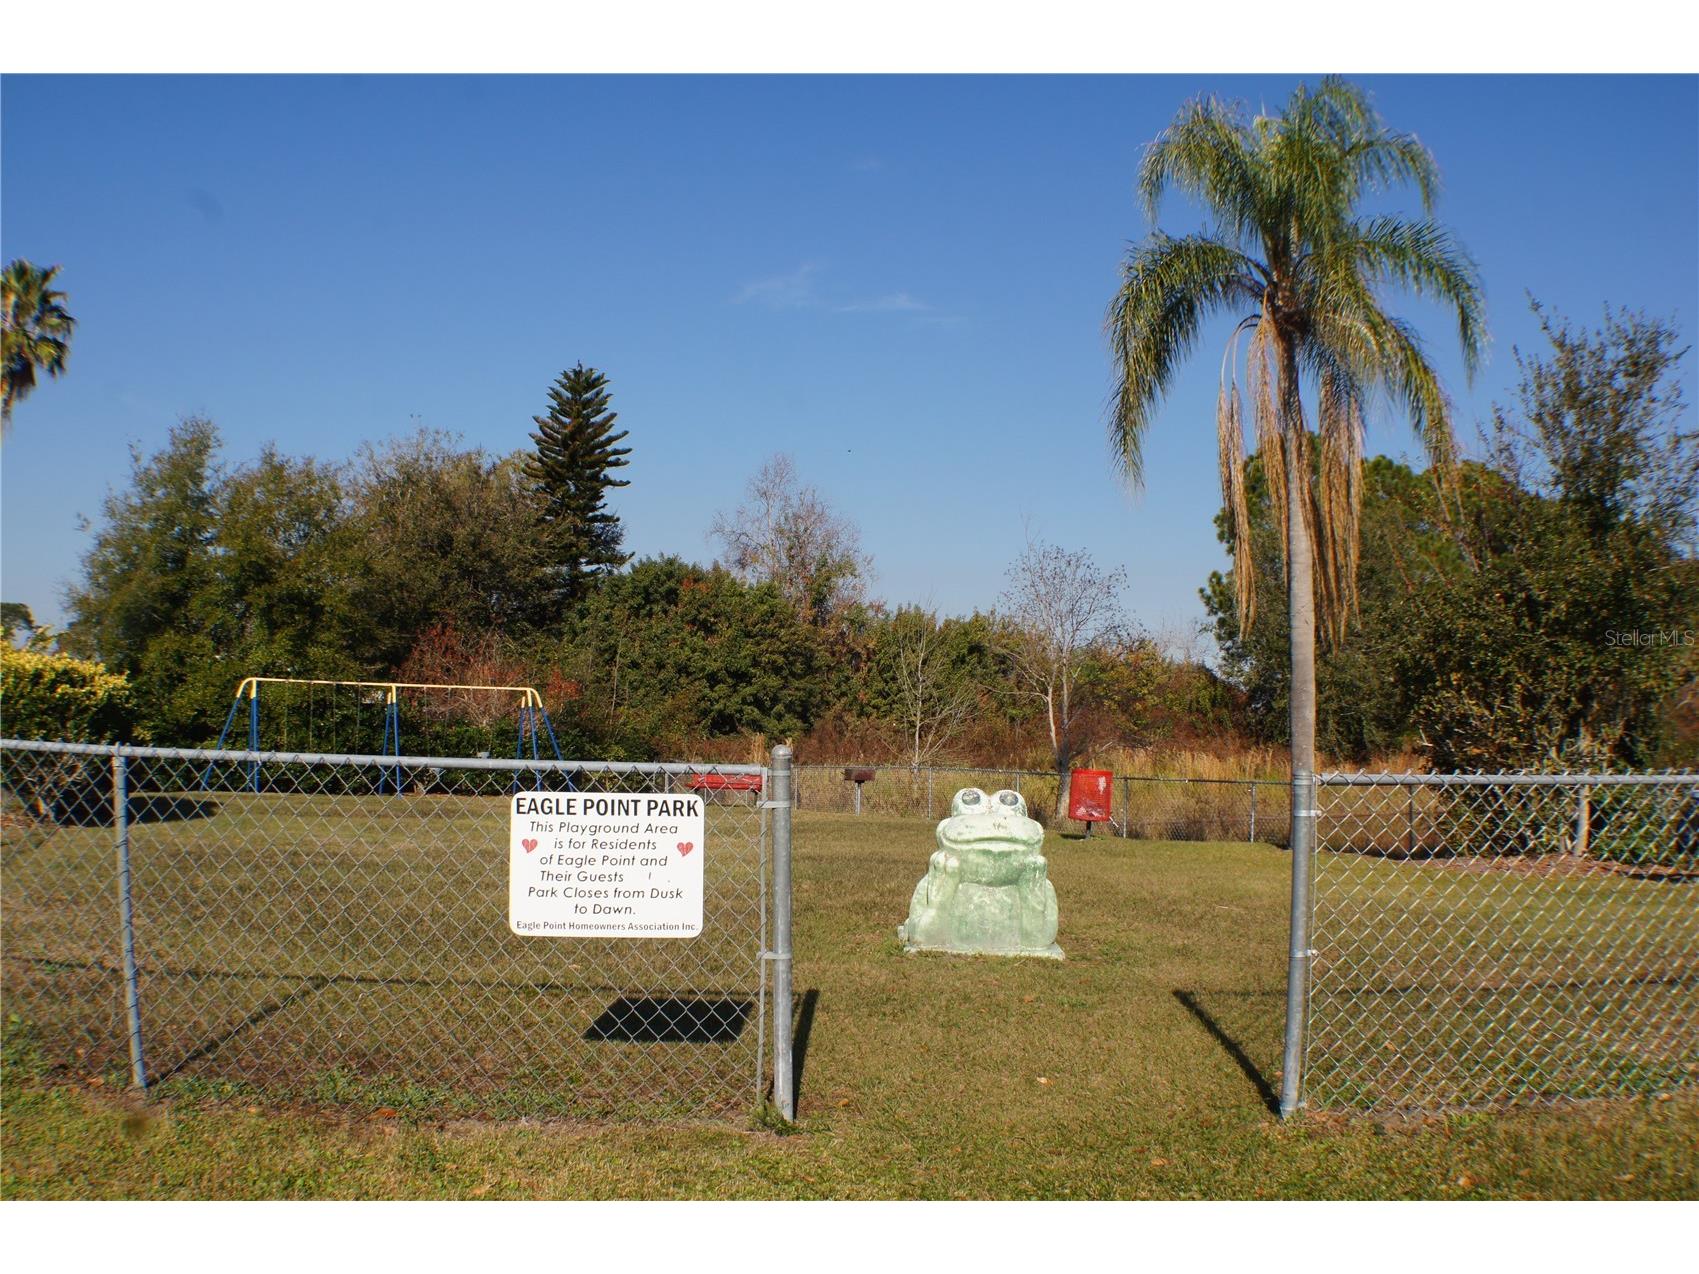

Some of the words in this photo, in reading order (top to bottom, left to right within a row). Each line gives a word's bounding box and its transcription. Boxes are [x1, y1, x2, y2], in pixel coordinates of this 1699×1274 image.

[516, 798, 577, 815] EAGLE
[583, 799, 640, 816] POINT
[647, 799, 699, 817] PARK
[530, 821, 554, 832] This
[559, 822, 639, 835] Playground
[644, 823, 678, 834] Area
[554, 838, 563, 849] is
[569, 838, 586, 849] for
[591, 839, 657, 850] Residents
[540, 854, 553, 865] of
[558, 855, 596, 868] Eagle
[602, 855, 635, 866] Point
[640, 856, 668, 866] and
[541, 871, 572, 881] Their
[577, 871, 624, 882] Guests
[528, 887, 557, 898] Park
[564, 888, 609, 898] Closes
[614, 888, 644, 898] from
[650, 888, 683, 899] Dusk
[575, 903, 587, 914] to
[593, 904, 636, 915] Dawn.
[517, 921, 540, 930] Eagle
[569, 922, 625, 930] Homeowners
[628, 922, 679, 930] Association
